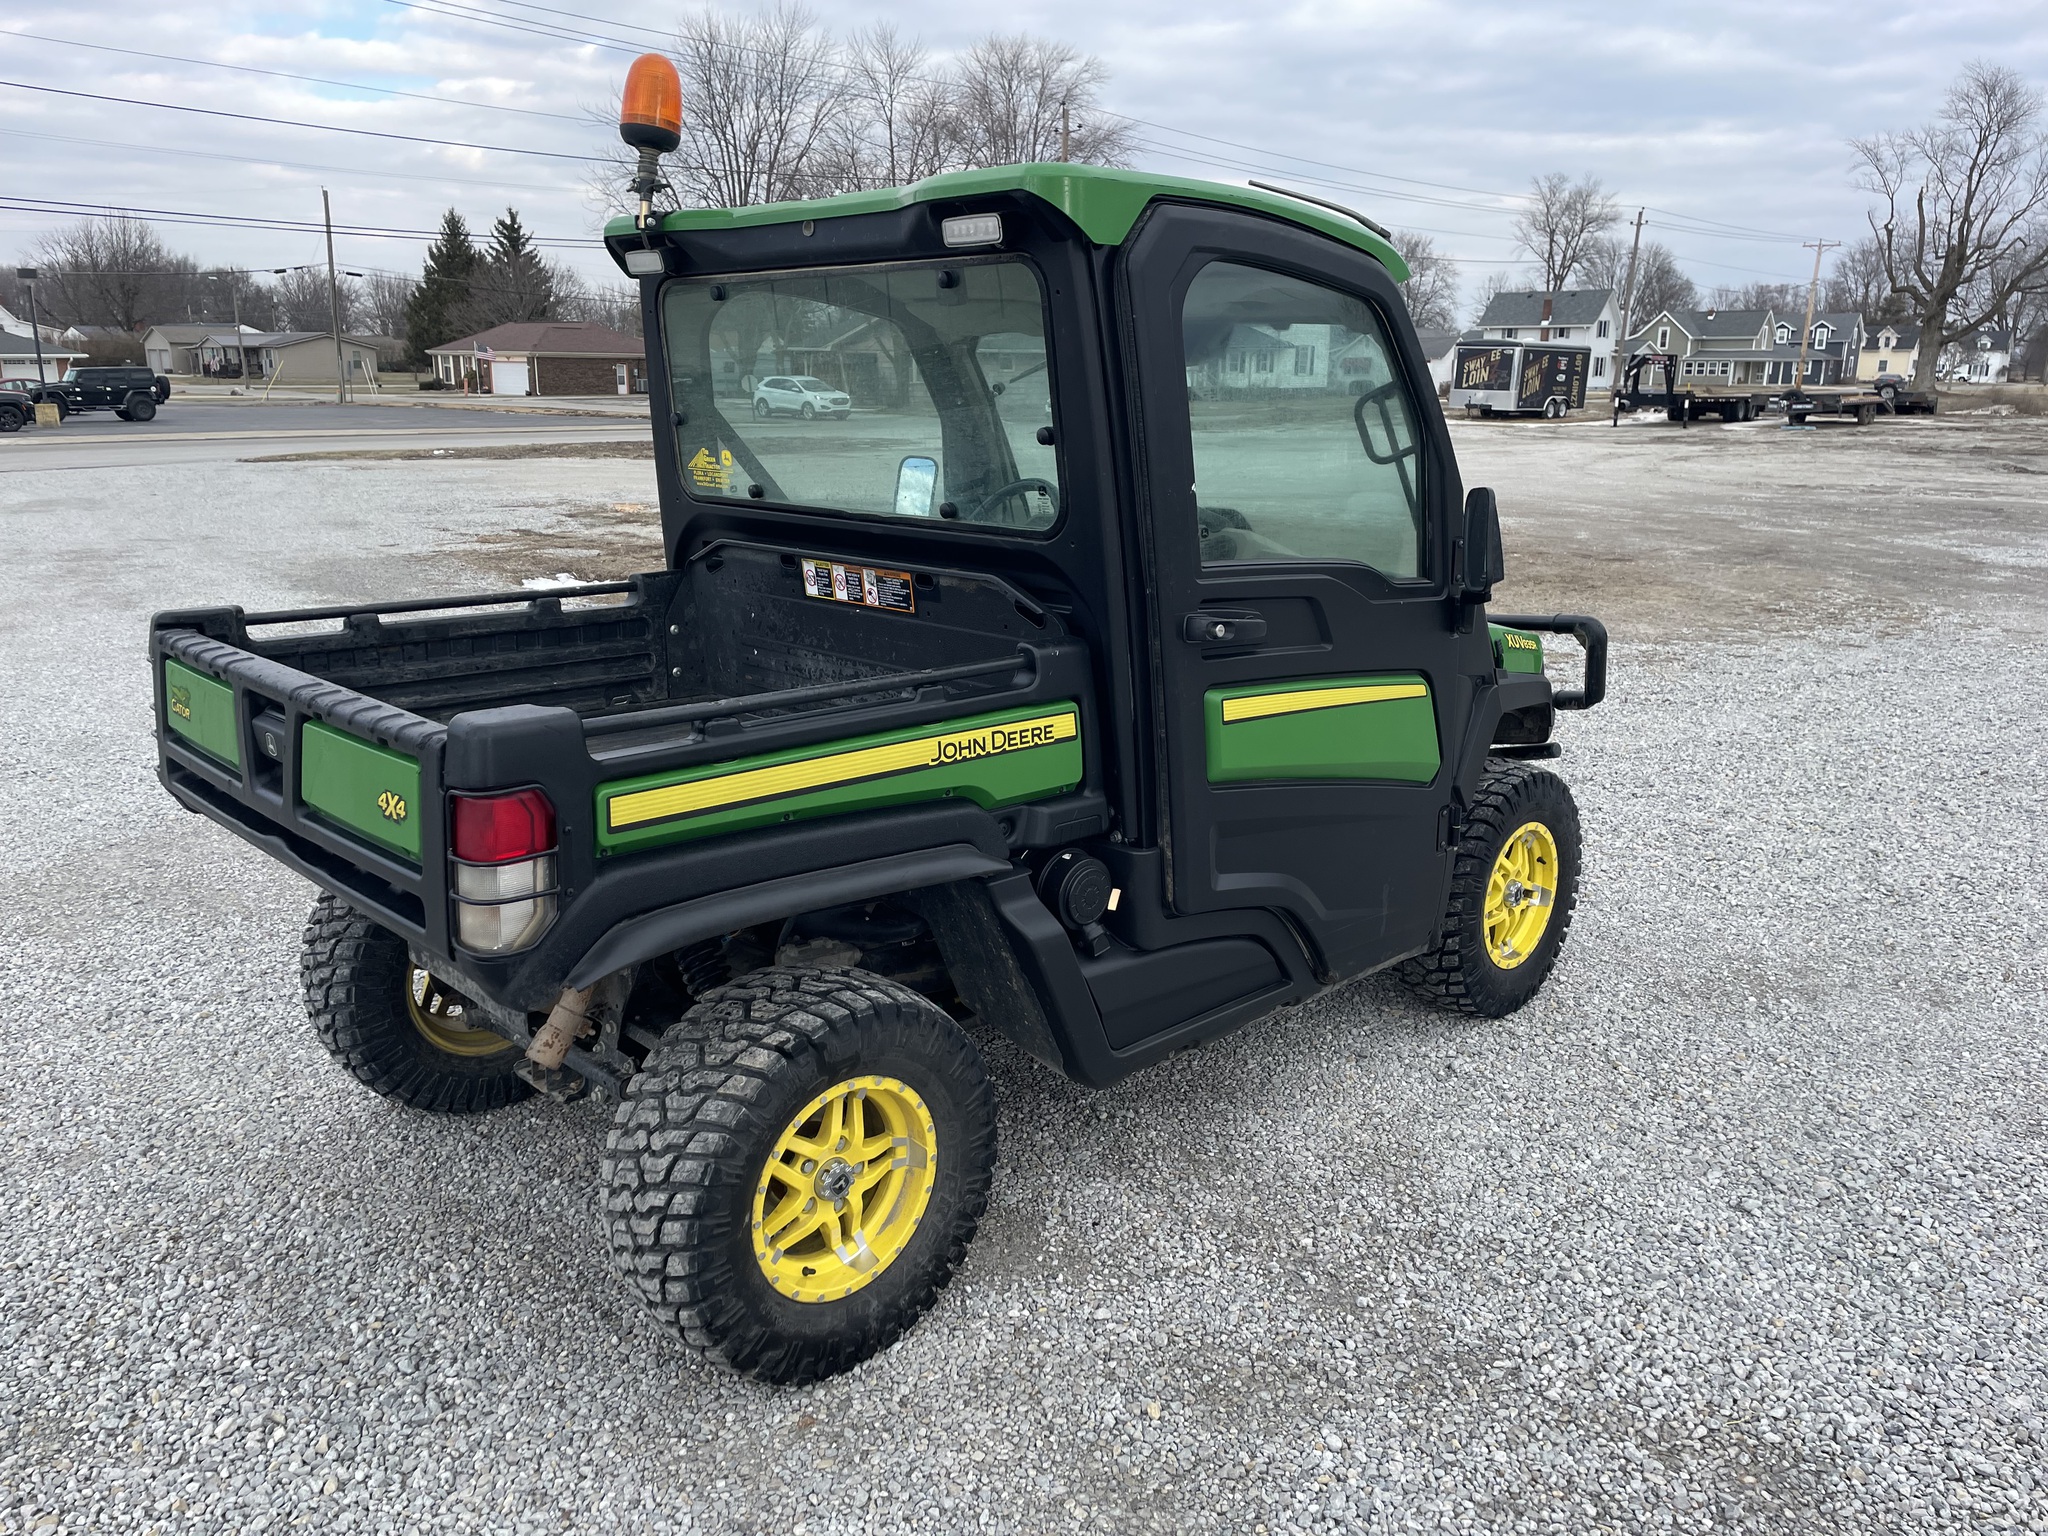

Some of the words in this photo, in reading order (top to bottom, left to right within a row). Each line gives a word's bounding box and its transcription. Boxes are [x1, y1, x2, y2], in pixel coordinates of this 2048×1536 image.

[1574, 353, 1583, 373] GOT
[1461, 365, 1490, 388] LOIN
[1521, 374, 1541, 399] LOIN
[171, 698, 191, 720] GATOR
[930, 737, 987, 763] JOHN
[991, 724, 1055, 751] DEERE
[377, 791, 406, 820] 4X4
